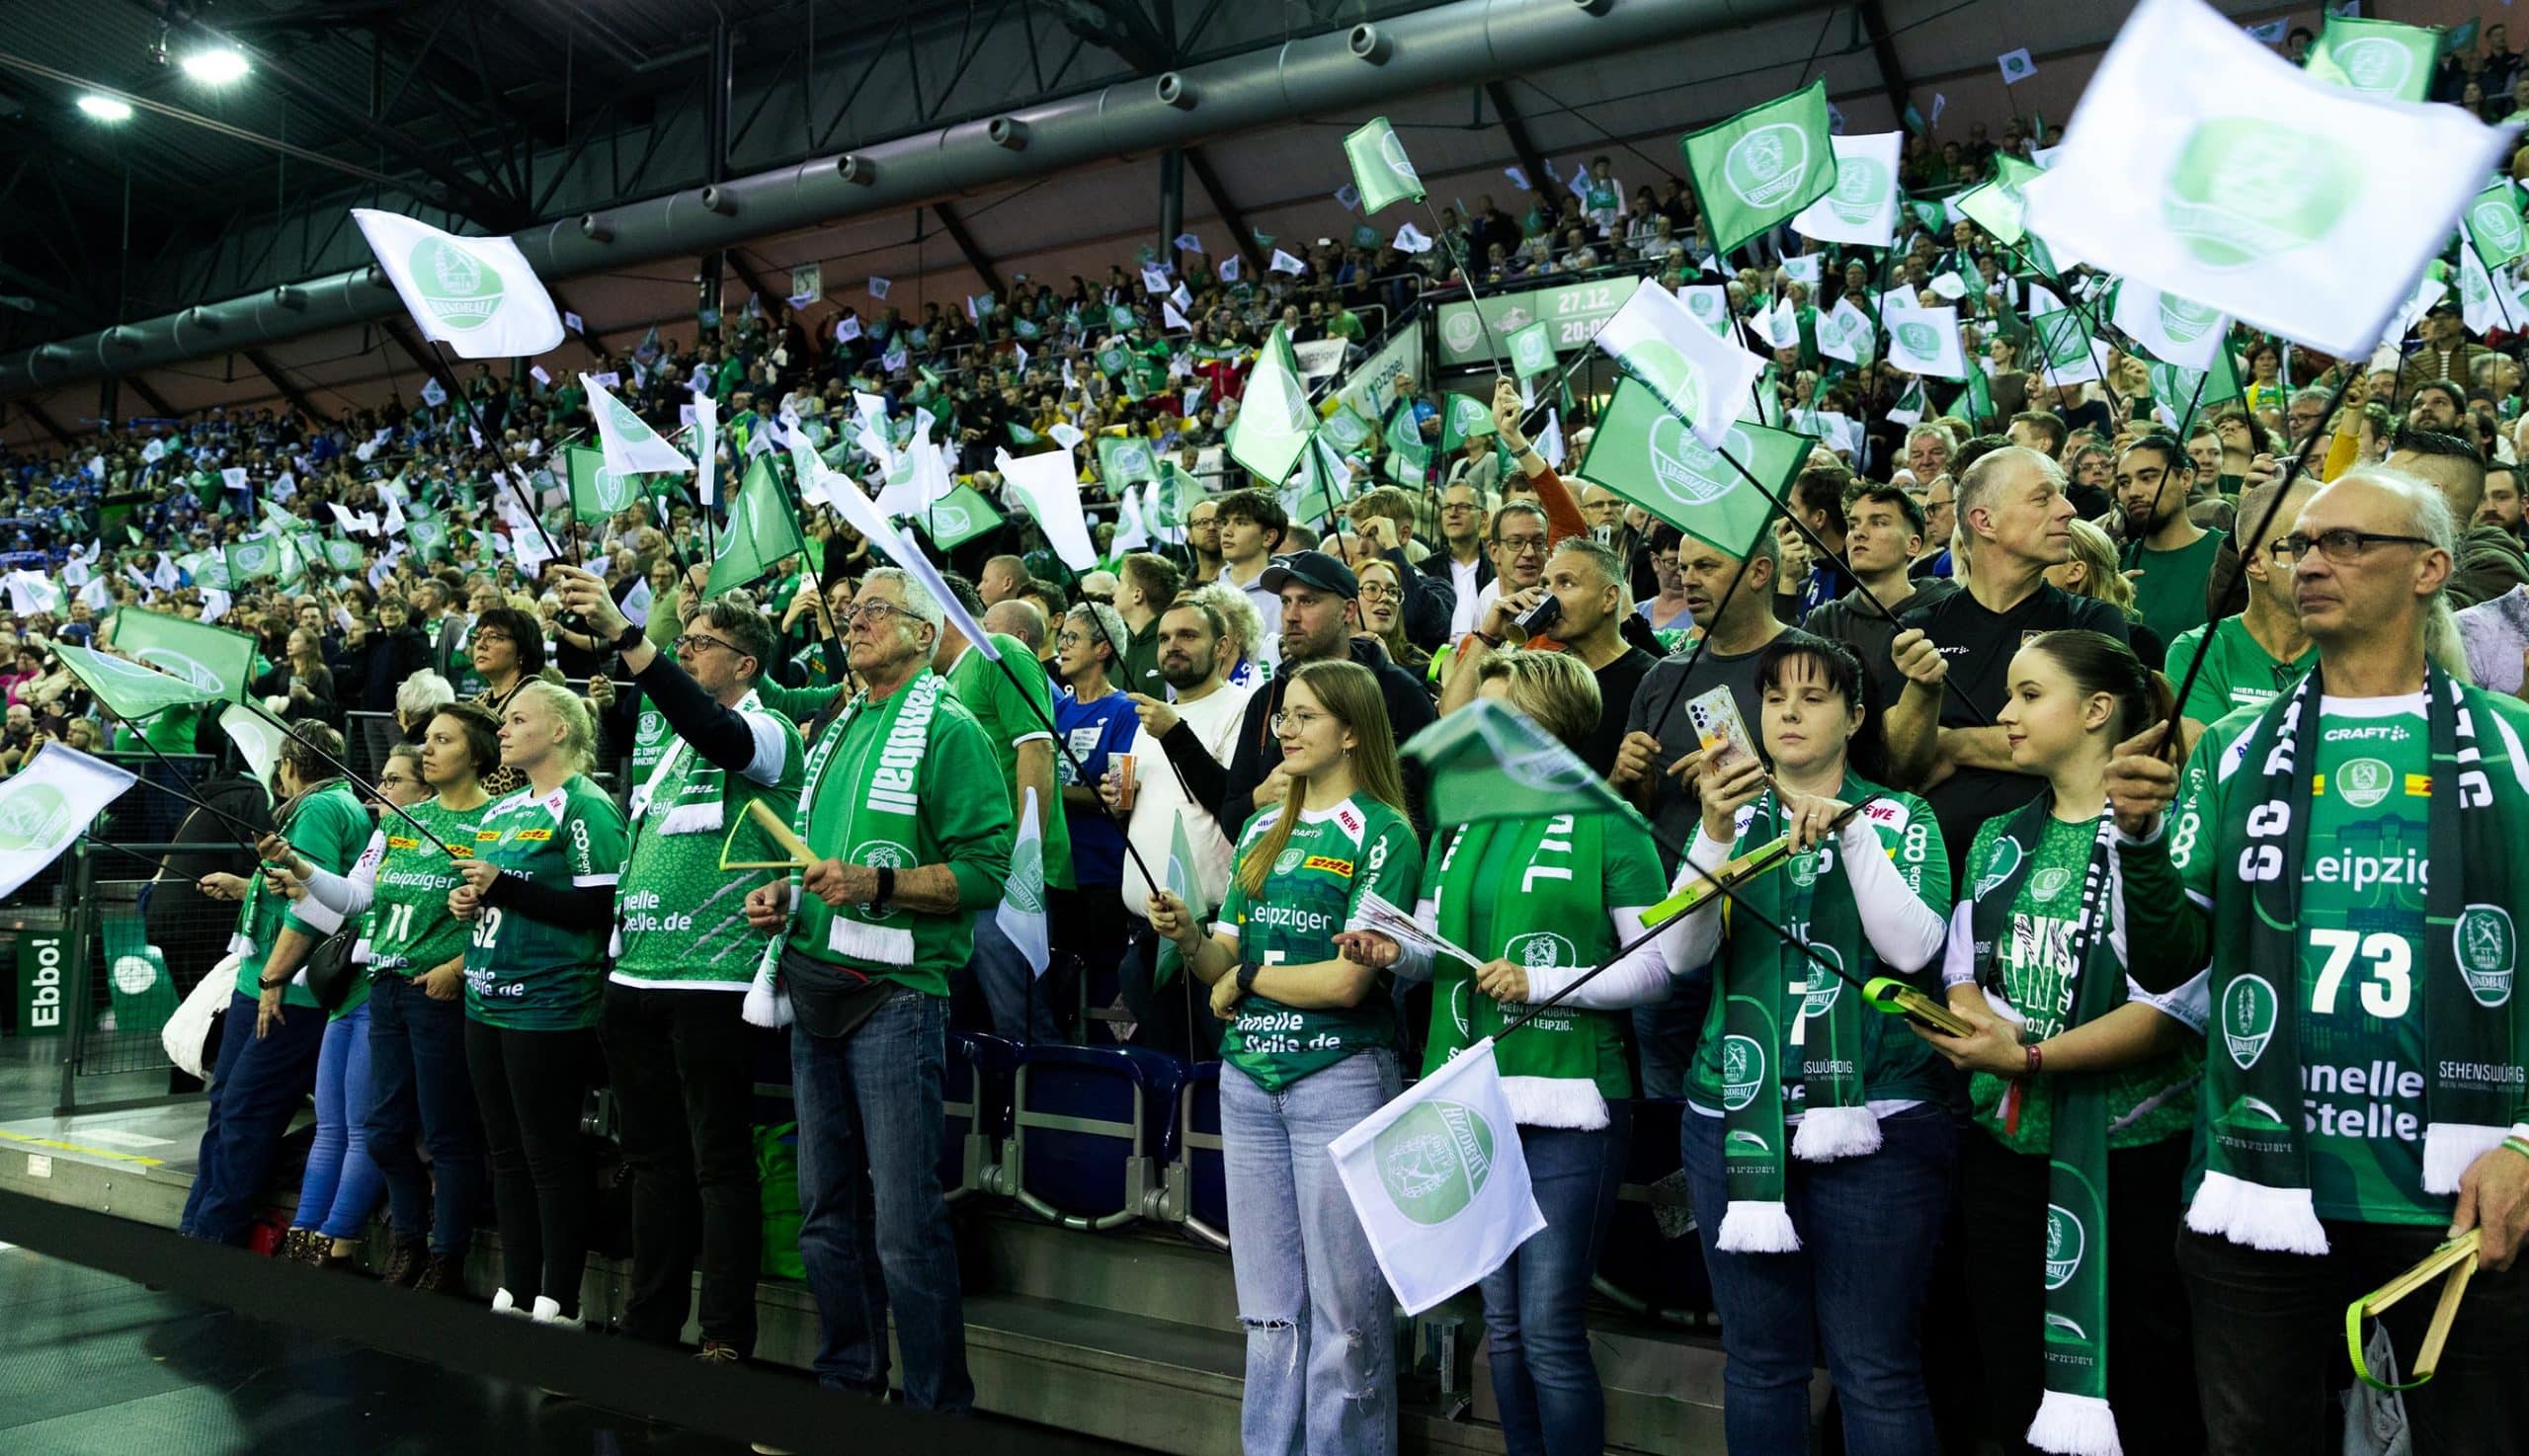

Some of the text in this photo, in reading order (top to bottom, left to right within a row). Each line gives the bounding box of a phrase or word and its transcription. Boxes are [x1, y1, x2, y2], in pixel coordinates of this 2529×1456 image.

[1558, 287, 1616, 314] 27.12.
[2325, 727, 2391, 741] CRAFT
[1340, 811, 1360, 835] REW
[1864, 805, 1897, 821] EWE
[1311, 857, 1352, 876] DHL
[382, 868, 458, 891] Leipziger
[386, 903, 415, 943] 11
[473, 906, 503, 949] 32
[32, 938, 60, 1027] Ebbo!
[2310, 929, 2412, 1019] 73
[1806, 993, 1830, 1006] DBALL
[1534, 1018, 1574, 1031] LEIPZIG.
[1723, 1086, 1753, 1099] NDBALL
[2046, 1264, 2068, 1277] BALL
